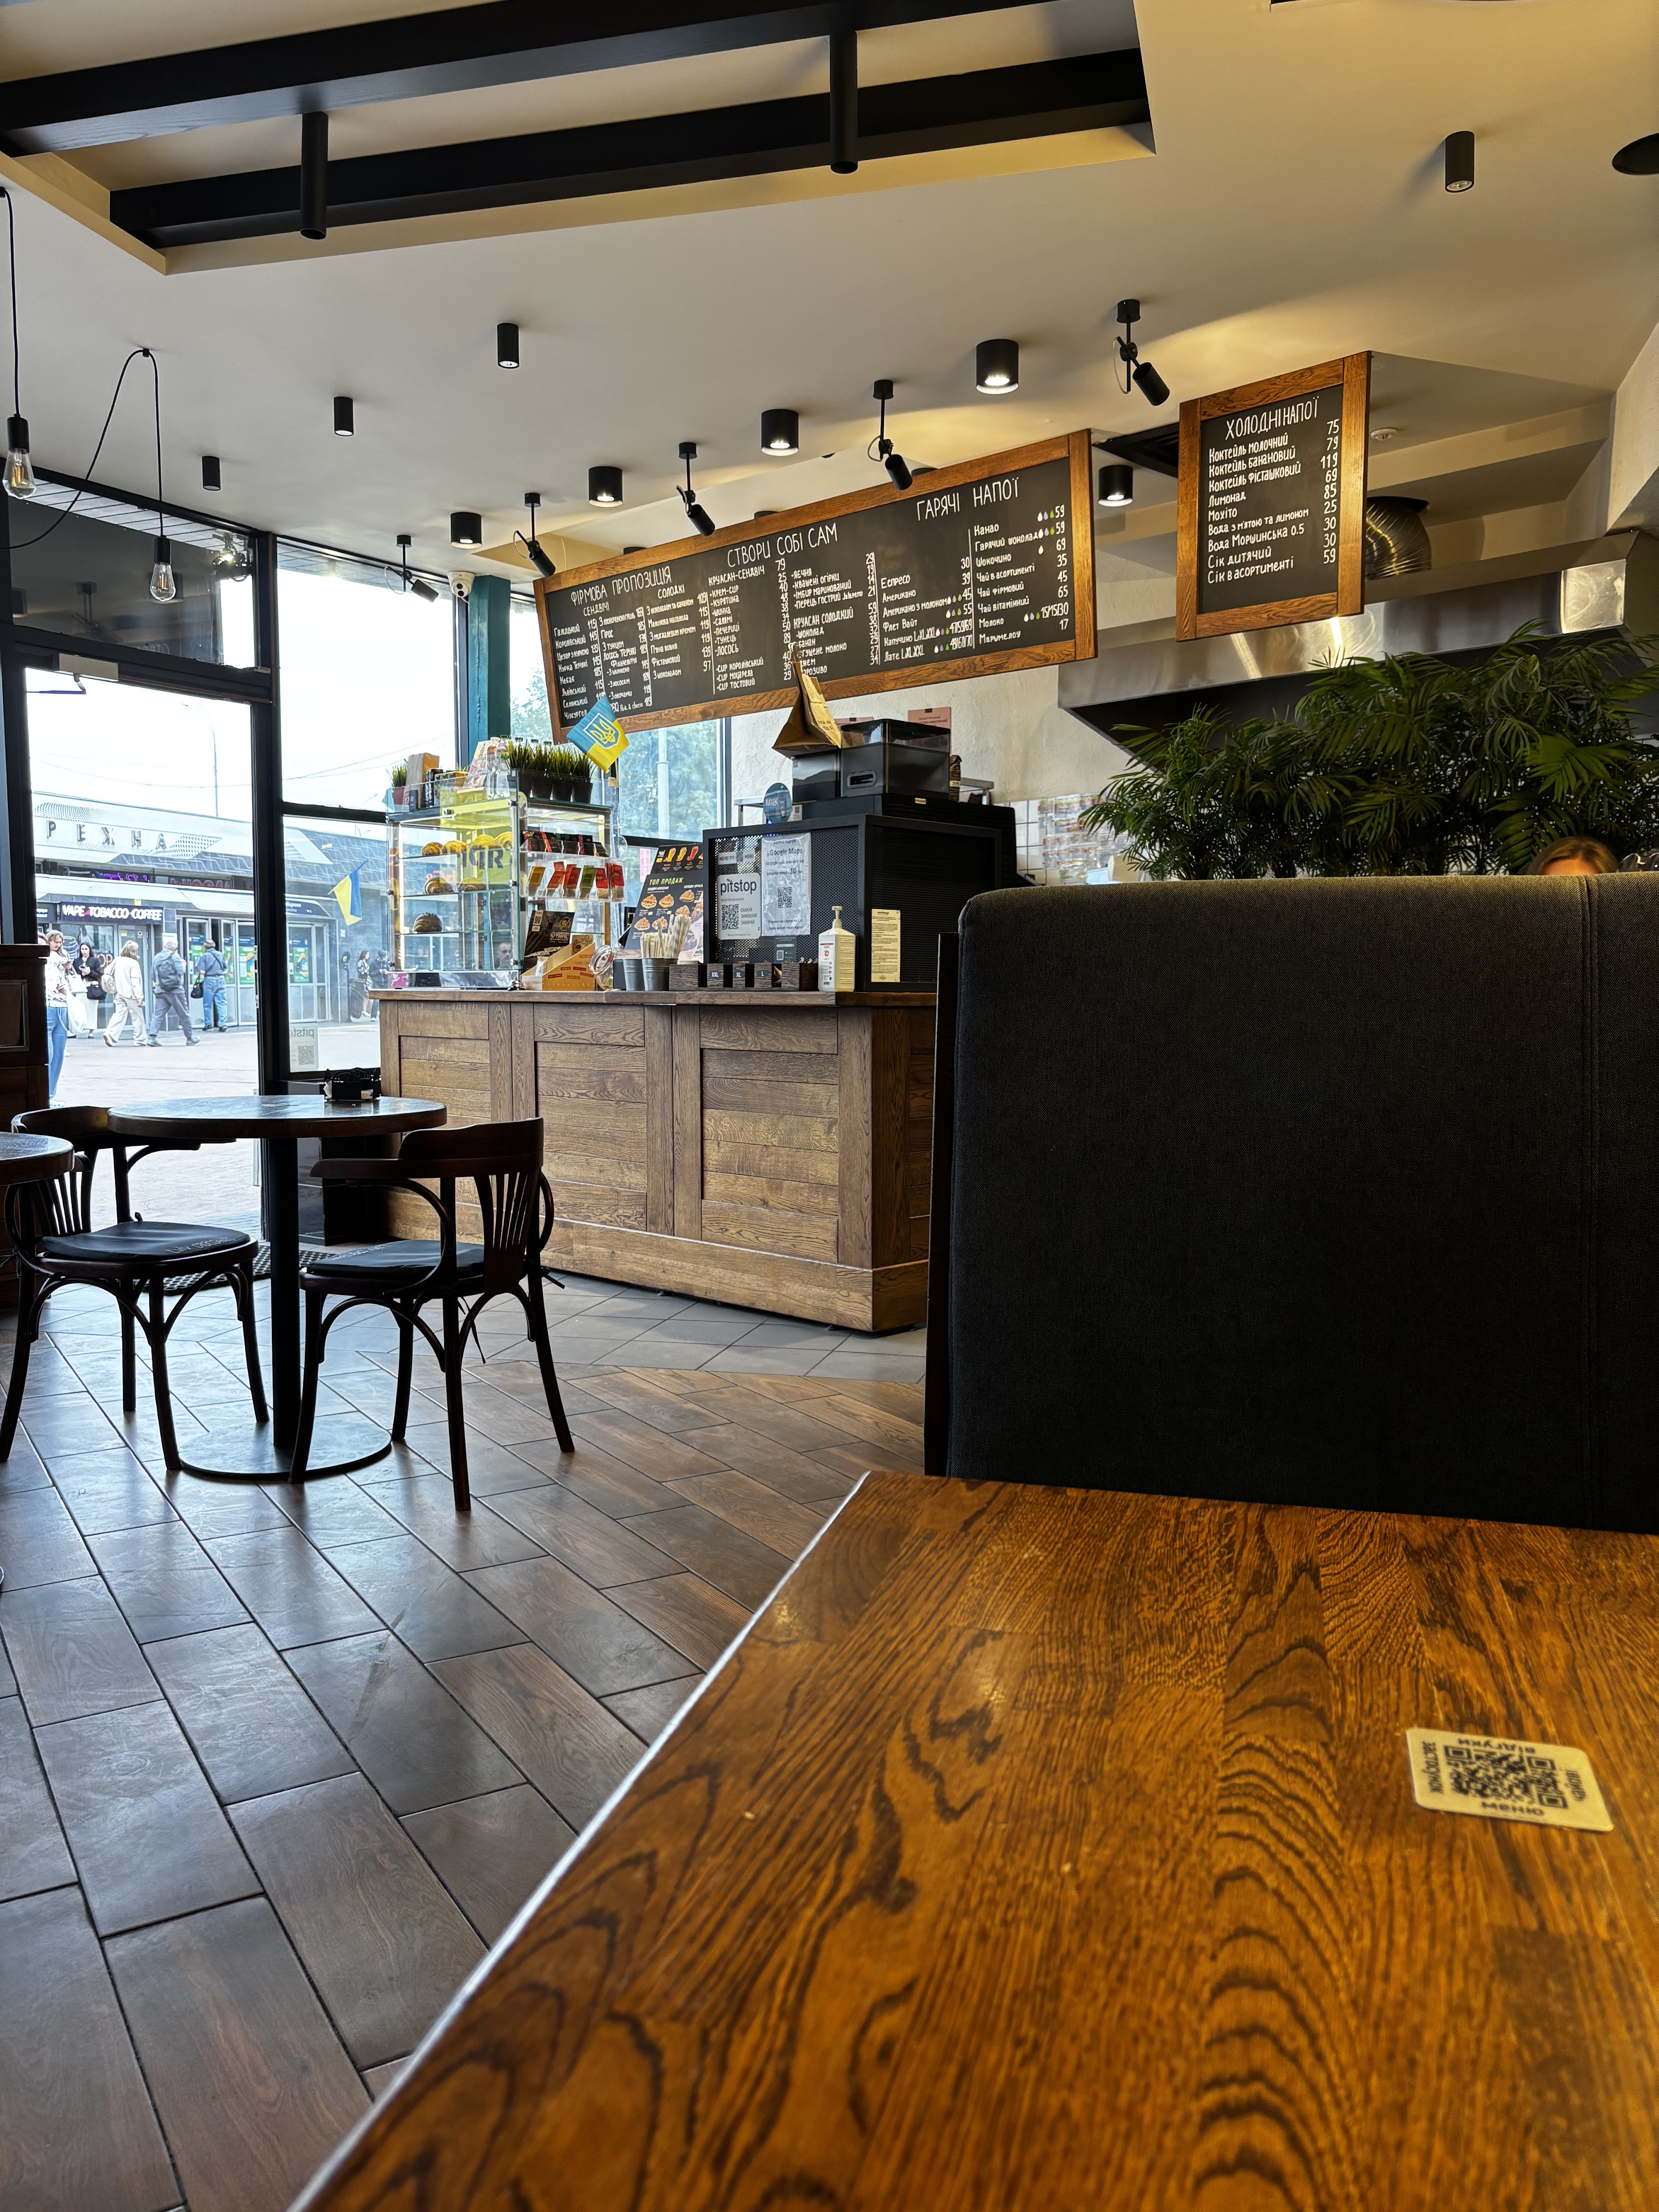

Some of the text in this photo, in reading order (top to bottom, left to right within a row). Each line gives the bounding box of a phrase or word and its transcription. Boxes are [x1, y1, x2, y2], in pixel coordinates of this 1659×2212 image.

[1225, 396, 1319, 440] ХОЛОДНІ НАПОЇ
[1209, 419, 1340, 464] Коктейль молочний 75
[1209, 436, 1339, 478] Коктейль банановий 79
[1209, 452, 1338, 493] Коктейль фісташковий 119
[1208, 468, 1337, 508] Лимонад 69
[917, 477, 1018, 521] ГАРЯЧІ НАПОЇ
[1208, 482, 1337, 522] Мохіто 85
[974, 505, 1065, 536] Какао 59
[1208, 524, 1229, 536] Вода
[1275, 509, 1309, 523] лимоном
[1324, 500, 1337, 514] 25
[975, 521, 1065, 552] Гарячий шоколад 59
[1208, 517, 1336, 553] Вода Моршинська 0.5 30
[727, 523, 837, 567] СТВОРИ СОБІ САМ
[1208, 532, 1336, 569] Сік дитячий 30
[866, 552, 874, 565] 29
[976, 538, 1066, 567] Шокочино 69
[708, 558, 785, 586] КРУАСАН-СЕНДВІЧ 79
[867, 564, 874, 575] 19
[976, 572, 989, 582] Чай
[1057, 553, 1067, 567] 35
[1207, 571, 1225, 584] Сік
[1234, 556, 1294, 579] асортименті
[1324, 548, 1336, 564] 59
[778, 572, 787, 582] 25
[867, 574, 875, 585] 14
[881, 557, 970, 589] Еспресо 30
[571, 566, 671, 606] ФІРМОВА ПРОПОЗИЦІЯ
[779, 582, 788, 592] 40
[882, 572, 971, 603] Американо 39
[977, 570, 1068, 598] Чай фірмовий 45
[658, 584, 685, 599] СОЛОДКІ
[781, 592, 788, 602] 48
[868, 585, 876, 597] 21
[697, 592, 706, 604] 109
[882, 605, 915, 618] Американо
[962, 588, 972, 600] 45
[977, 585, 1068, 613] Чай вітамінний 65
[583, 601, 609, 616] СЕНДВІЧІ
[699, 606, 708, 617] 115
[781, 602, 788, 612] 38
[782, 612, 789, 622] 34
[793, 601, 877, 629] КРУАСАН СОЛОДКИЙ 59
[869, 614, 877, 625] 38
[883, 602, 972, 632] Флет Вайт 55
[588, 618, 596, 629] 115
[700, 619, 709, 630] 119
[782, 621, 791, 632] 50
[869, 625, 878, 635] 32
[978, 618, 1004, 629] Молоко
[1059, 618, 1069, 630] 17
[701, 633, 710, 643] 119
[783, 632, 791, 644] 89
[870, 634, 878, 644] 29
[884, 634, 912, 647] Капучино
[702, 646, 711, 658] 139
[782, 651, 791, 662] 40
[871, 645, 879, 655] 27
[884, 651, 900, 662] Лате
[703, 660, 711, 671] 97
[784, 661, 791, 671] 36
[870, 654, 879, 665] 34
[784, 670, 792, 681] 29
[595, 679, 603, 689] 115
[721, 878, 757, 896] pitstop
[62, 905, 86, 917] VAPE
[88, 906, 129, 919] TOBACCO
